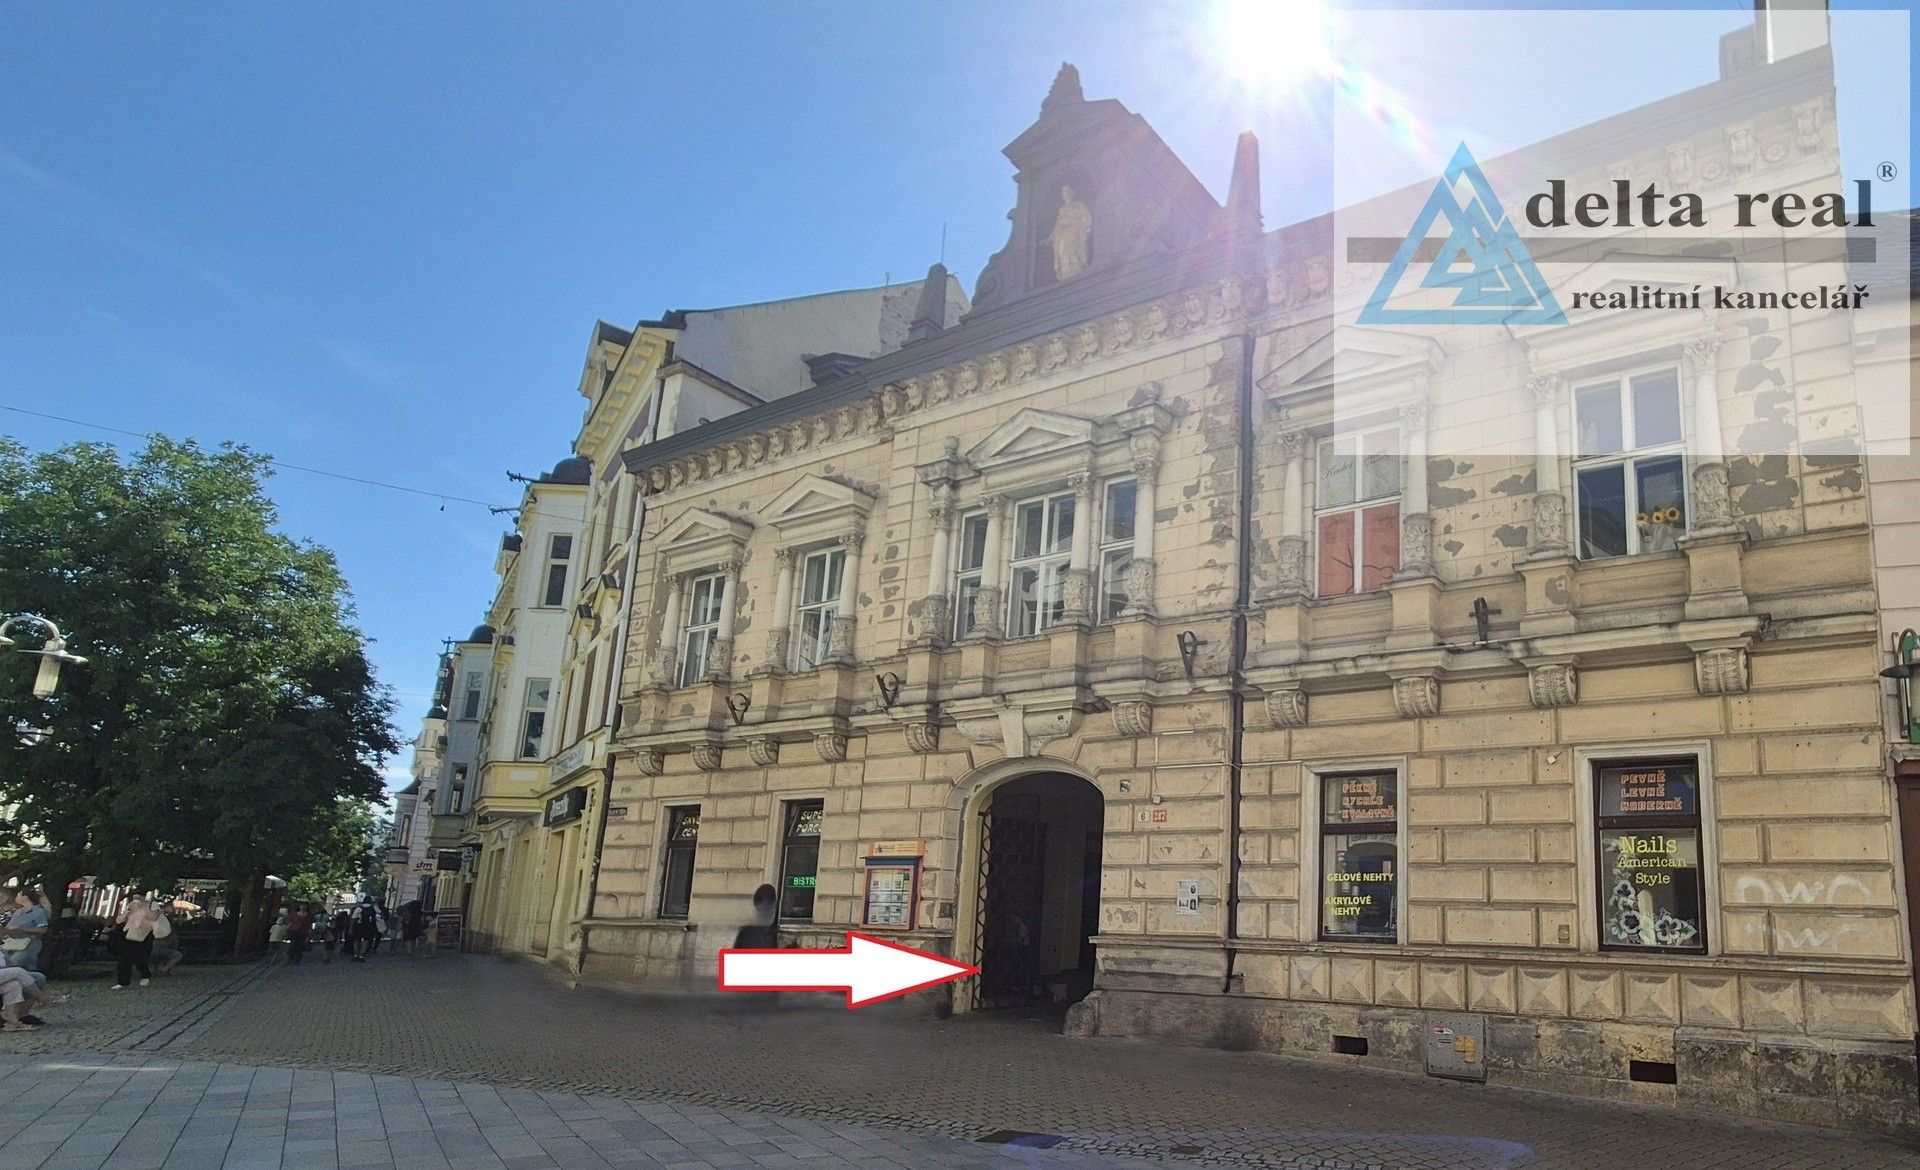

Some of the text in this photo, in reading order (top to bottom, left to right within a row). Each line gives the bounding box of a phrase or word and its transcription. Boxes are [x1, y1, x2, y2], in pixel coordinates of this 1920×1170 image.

[1621, 769, 1666, 784] PEVNĚ
[1621, 783, 1665, 798] LEVNĚ
[1621, 796, 1683, 811] MODERNĚ
[1620, 835, 1678, 854] Nails
[1617, 857, 1688, 868] American
[1327, 871, 1394, 882] GELOVÉ NEHTY
[1635, 872, 1671, 887] Style
[1325, 894, 1372, 905] AKRYLOVÉ
[1332, 906, 1361, 916] NEHTY
